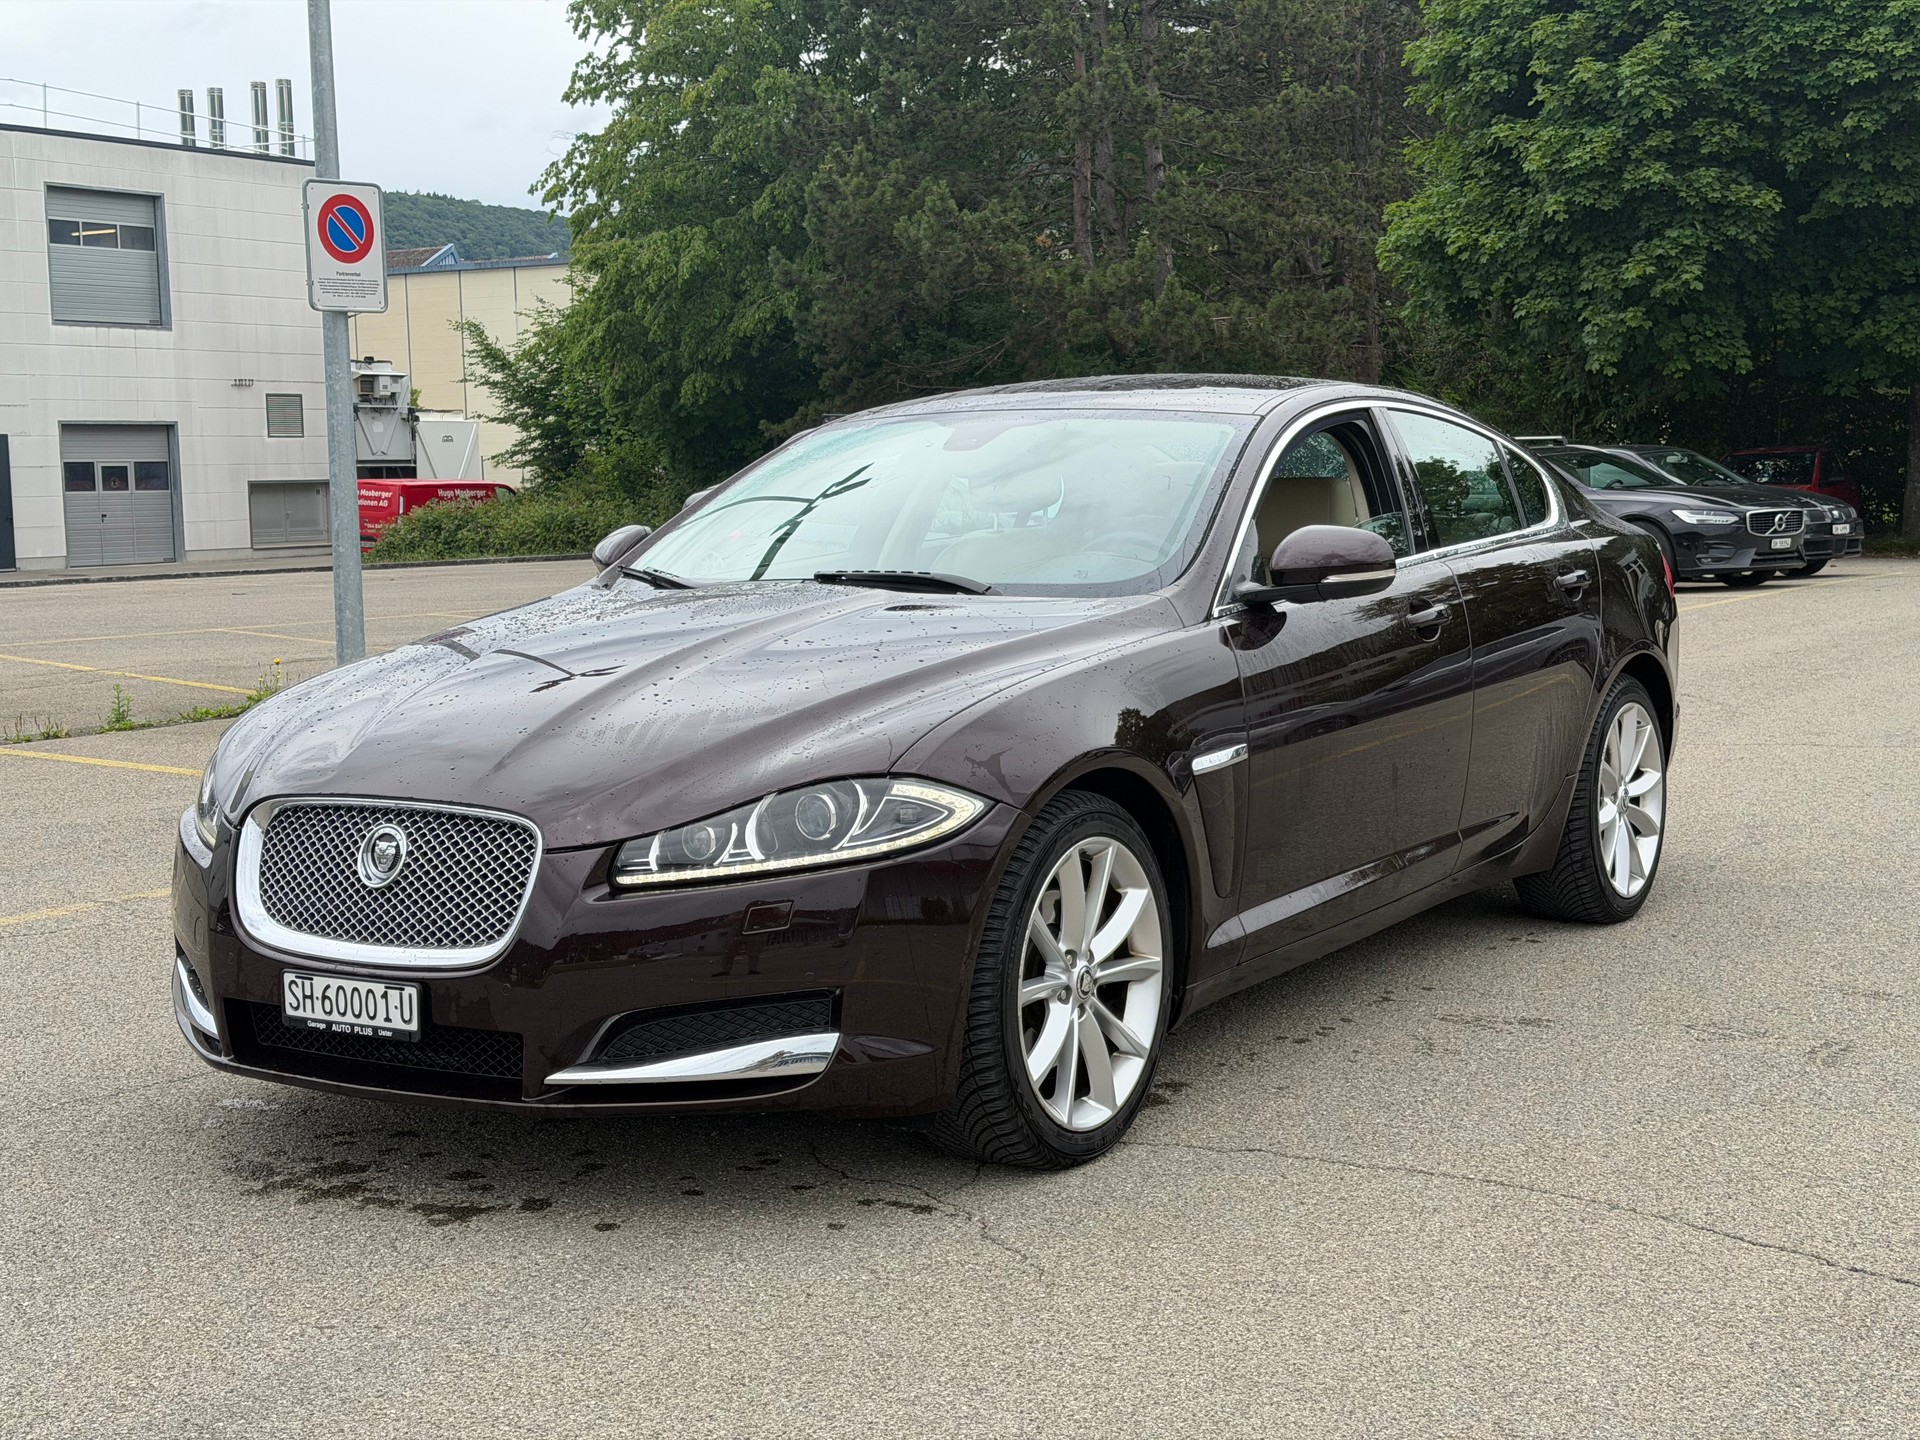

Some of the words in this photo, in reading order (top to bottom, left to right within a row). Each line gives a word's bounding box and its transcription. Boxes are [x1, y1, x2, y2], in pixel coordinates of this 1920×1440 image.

[361, 489, 393, 499] Mosberger
[438, 489, 454, 498] Hugo
[455, 489, 486, 498] Mosberger
[307, 1020, 326, 1030] Garage
[331, 1023, 351, 1034] AUTO
[354, 1026, 373, 1037] PLUS
[378, 1029, 393, 1037] Uster
